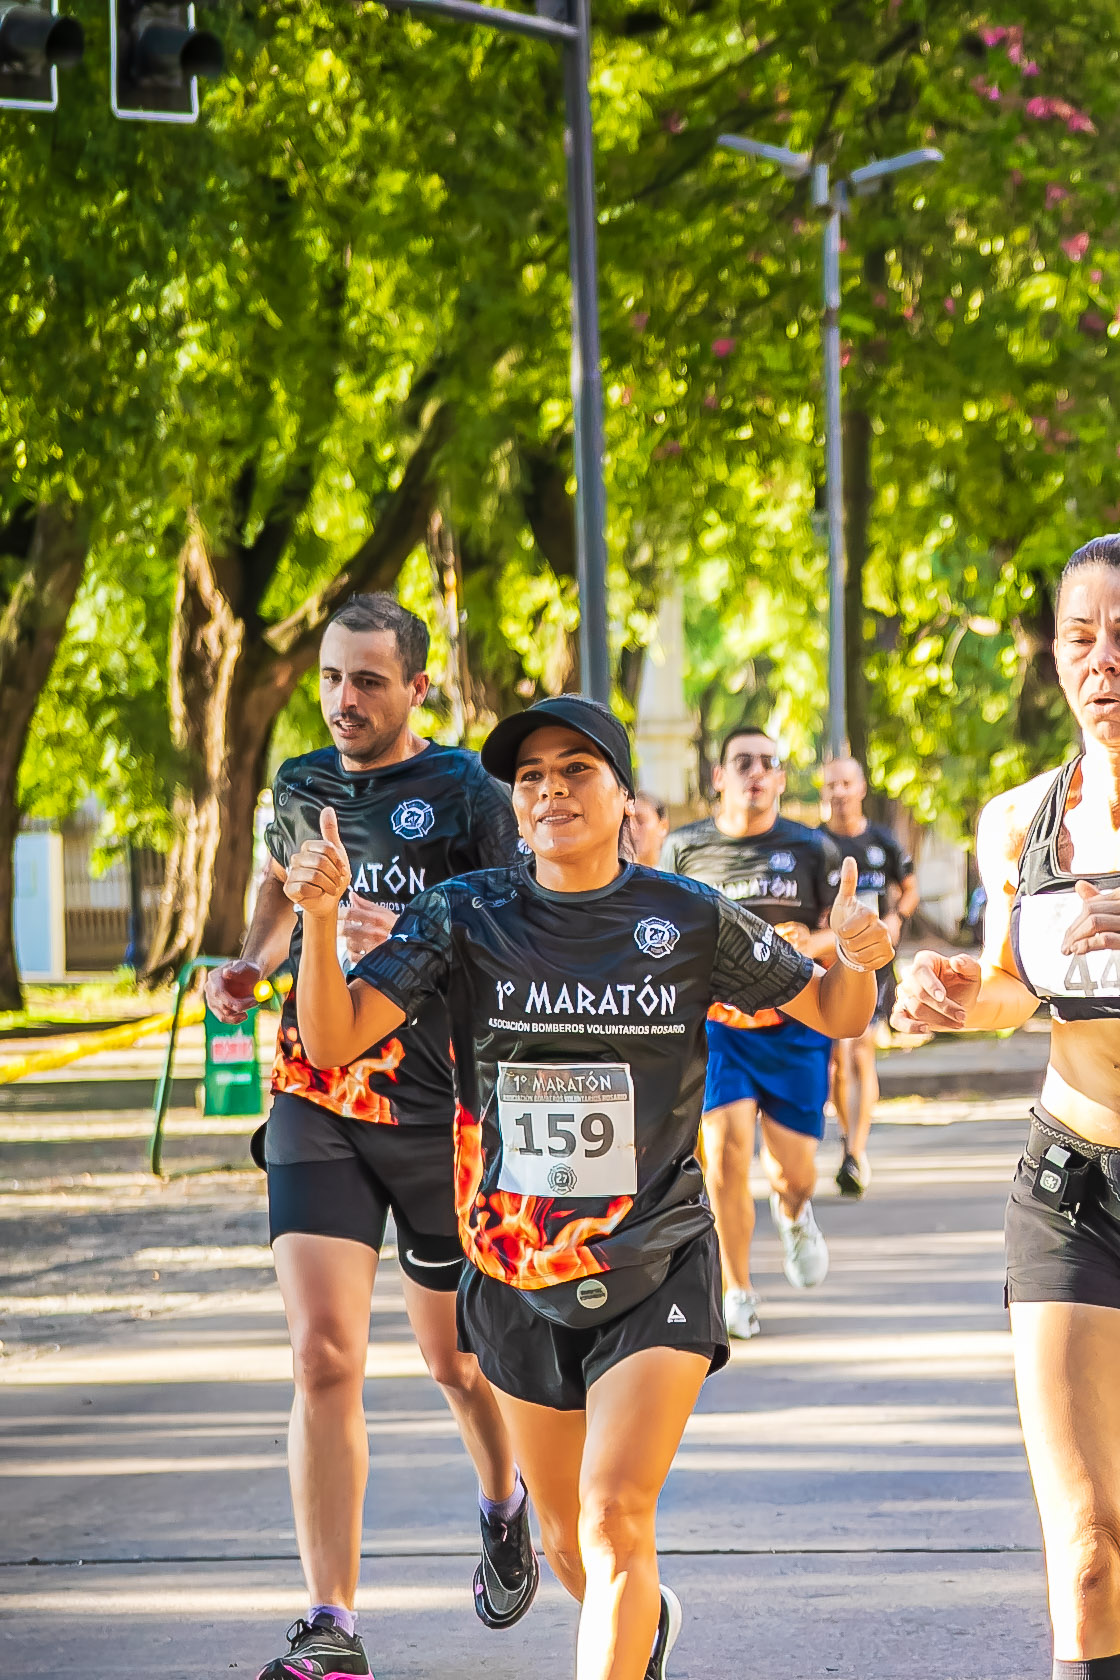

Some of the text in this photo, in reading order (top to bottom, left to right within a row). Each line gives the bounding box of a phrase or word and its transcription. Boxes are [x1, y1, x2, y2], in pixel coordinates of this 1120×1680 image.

[348, 856, 426, 894] ATÓN
[525, 974, 676, 1016] MARATÓN
[488, 1017, 686, 1035] ASOCIACIÓN BOMBEROS VOLUNTARIOS ROSARIO
[532, 1071, 612, 1092] MARATÓN
[515, 1112, 615, 1158] 159
